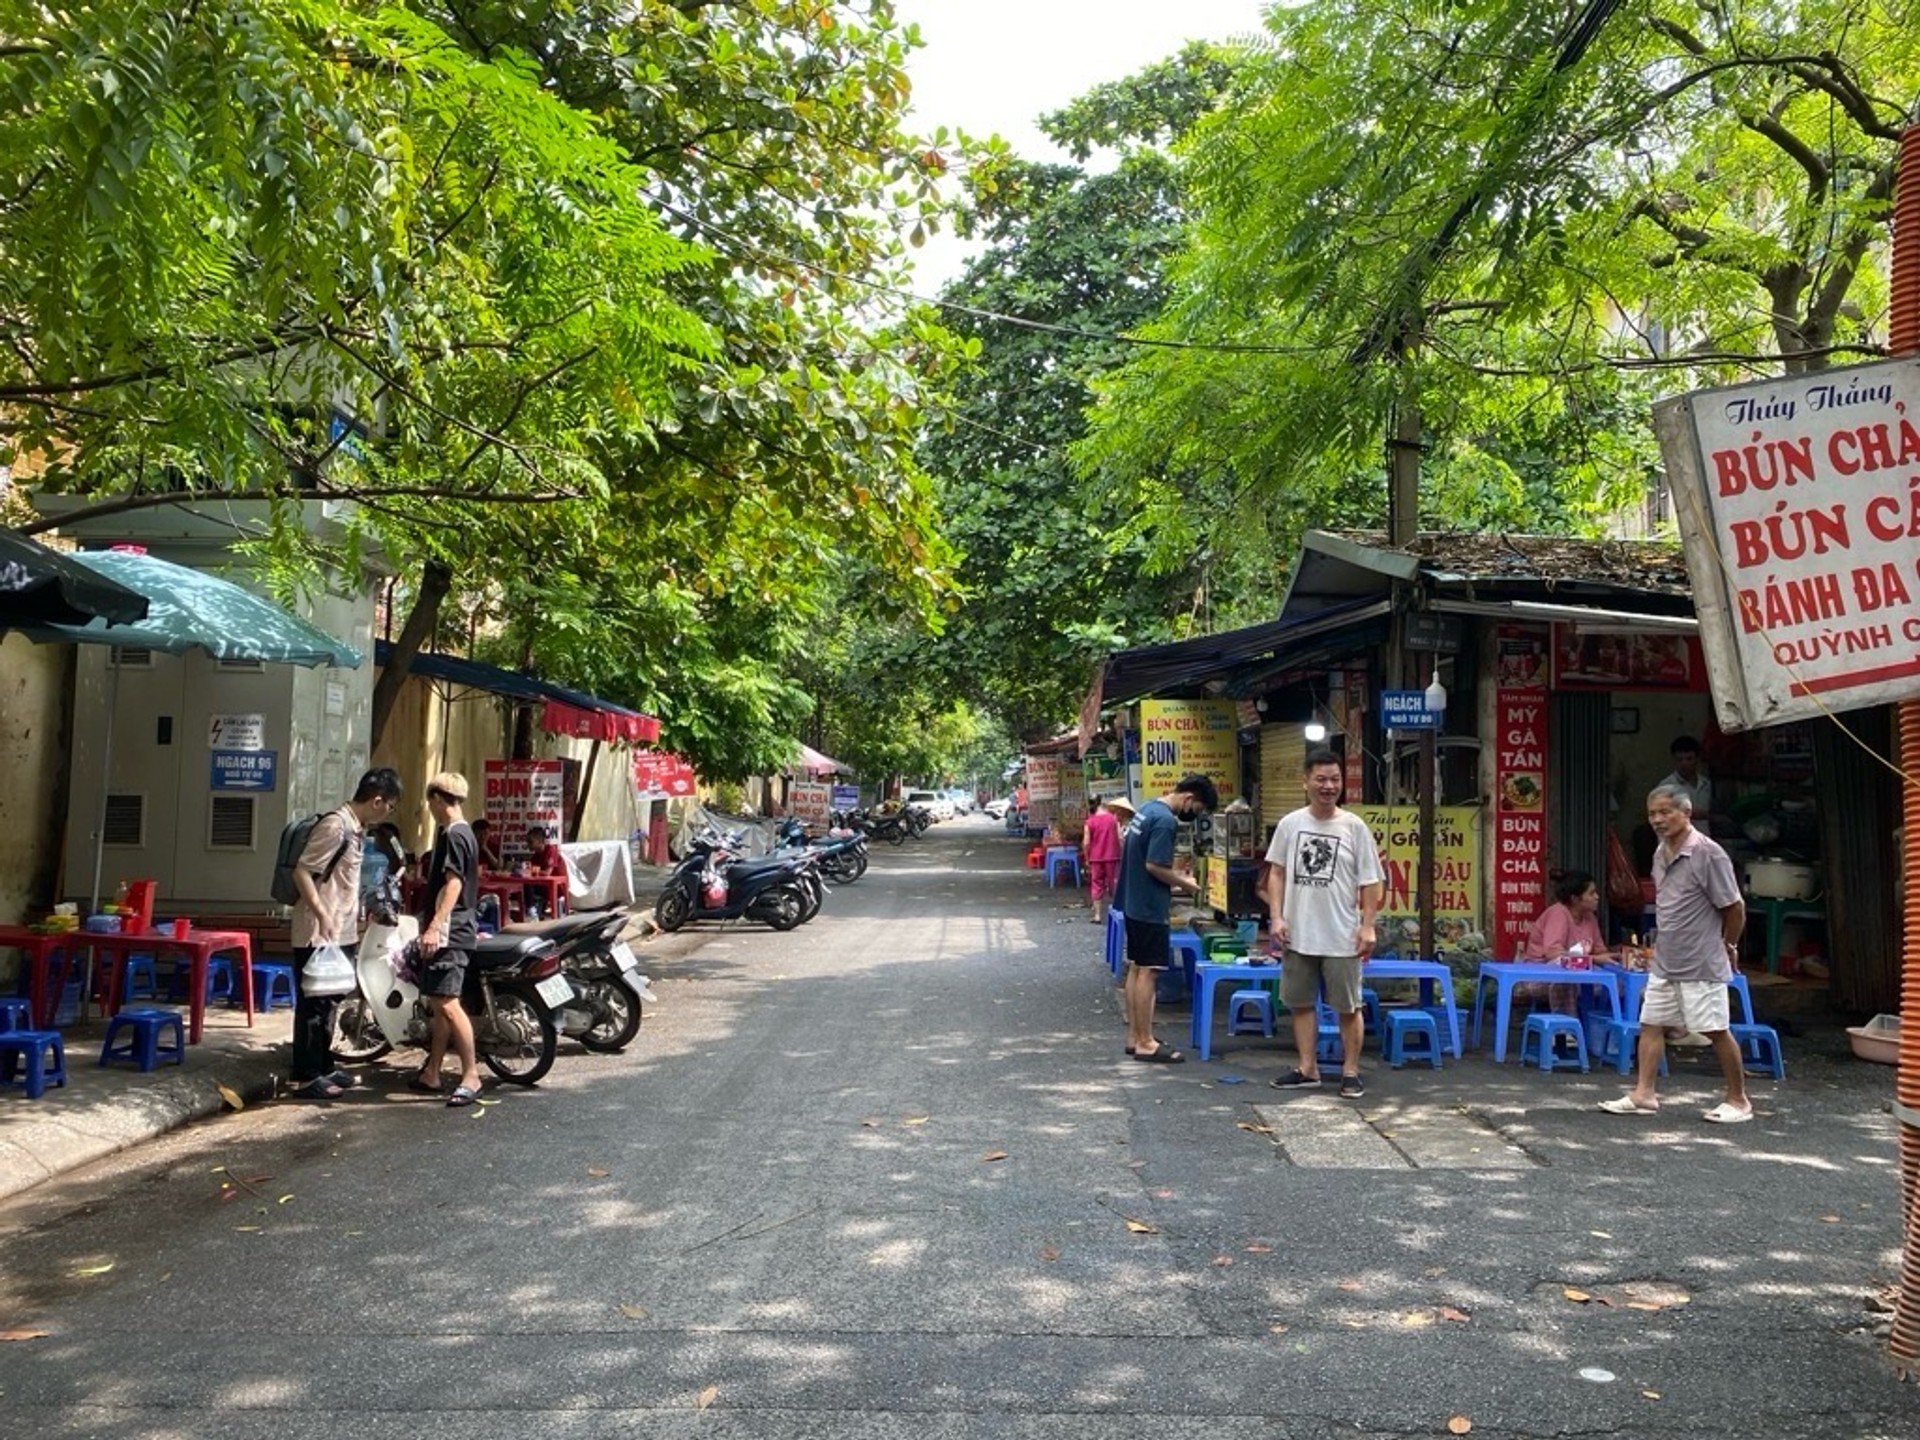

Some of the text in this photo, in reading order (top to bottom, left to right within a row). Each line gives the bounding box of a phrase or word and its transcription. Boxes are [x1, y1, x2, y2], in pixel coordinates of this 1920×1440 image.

[1725, 376, 1894, 425] Thúy Thắng
[1712, 431, 1816, 497] BÚN
[1730, 501, 1850, 569] BÚN
[1738, 573, 1845, 635] BÁNH
[1851, 561, 1911, 613] ĐA
[1773, 624, 1893, 665] QUỲNH
[1385, 694, 1422, 711] NGÁCH
[1147, 714, 1199, 731] BÚN CHẢ
[1507, 705, 1538, 723] MỲ
[1507, 728, 1537, 745] GÀ
[1146, 736, 1175, 766] BÚN
[1502, 816, 1539, 832] BÚN
[1502, 836, 1540, 856] ĐẬU
[1502, 857, 1540, 873] CHẢ
